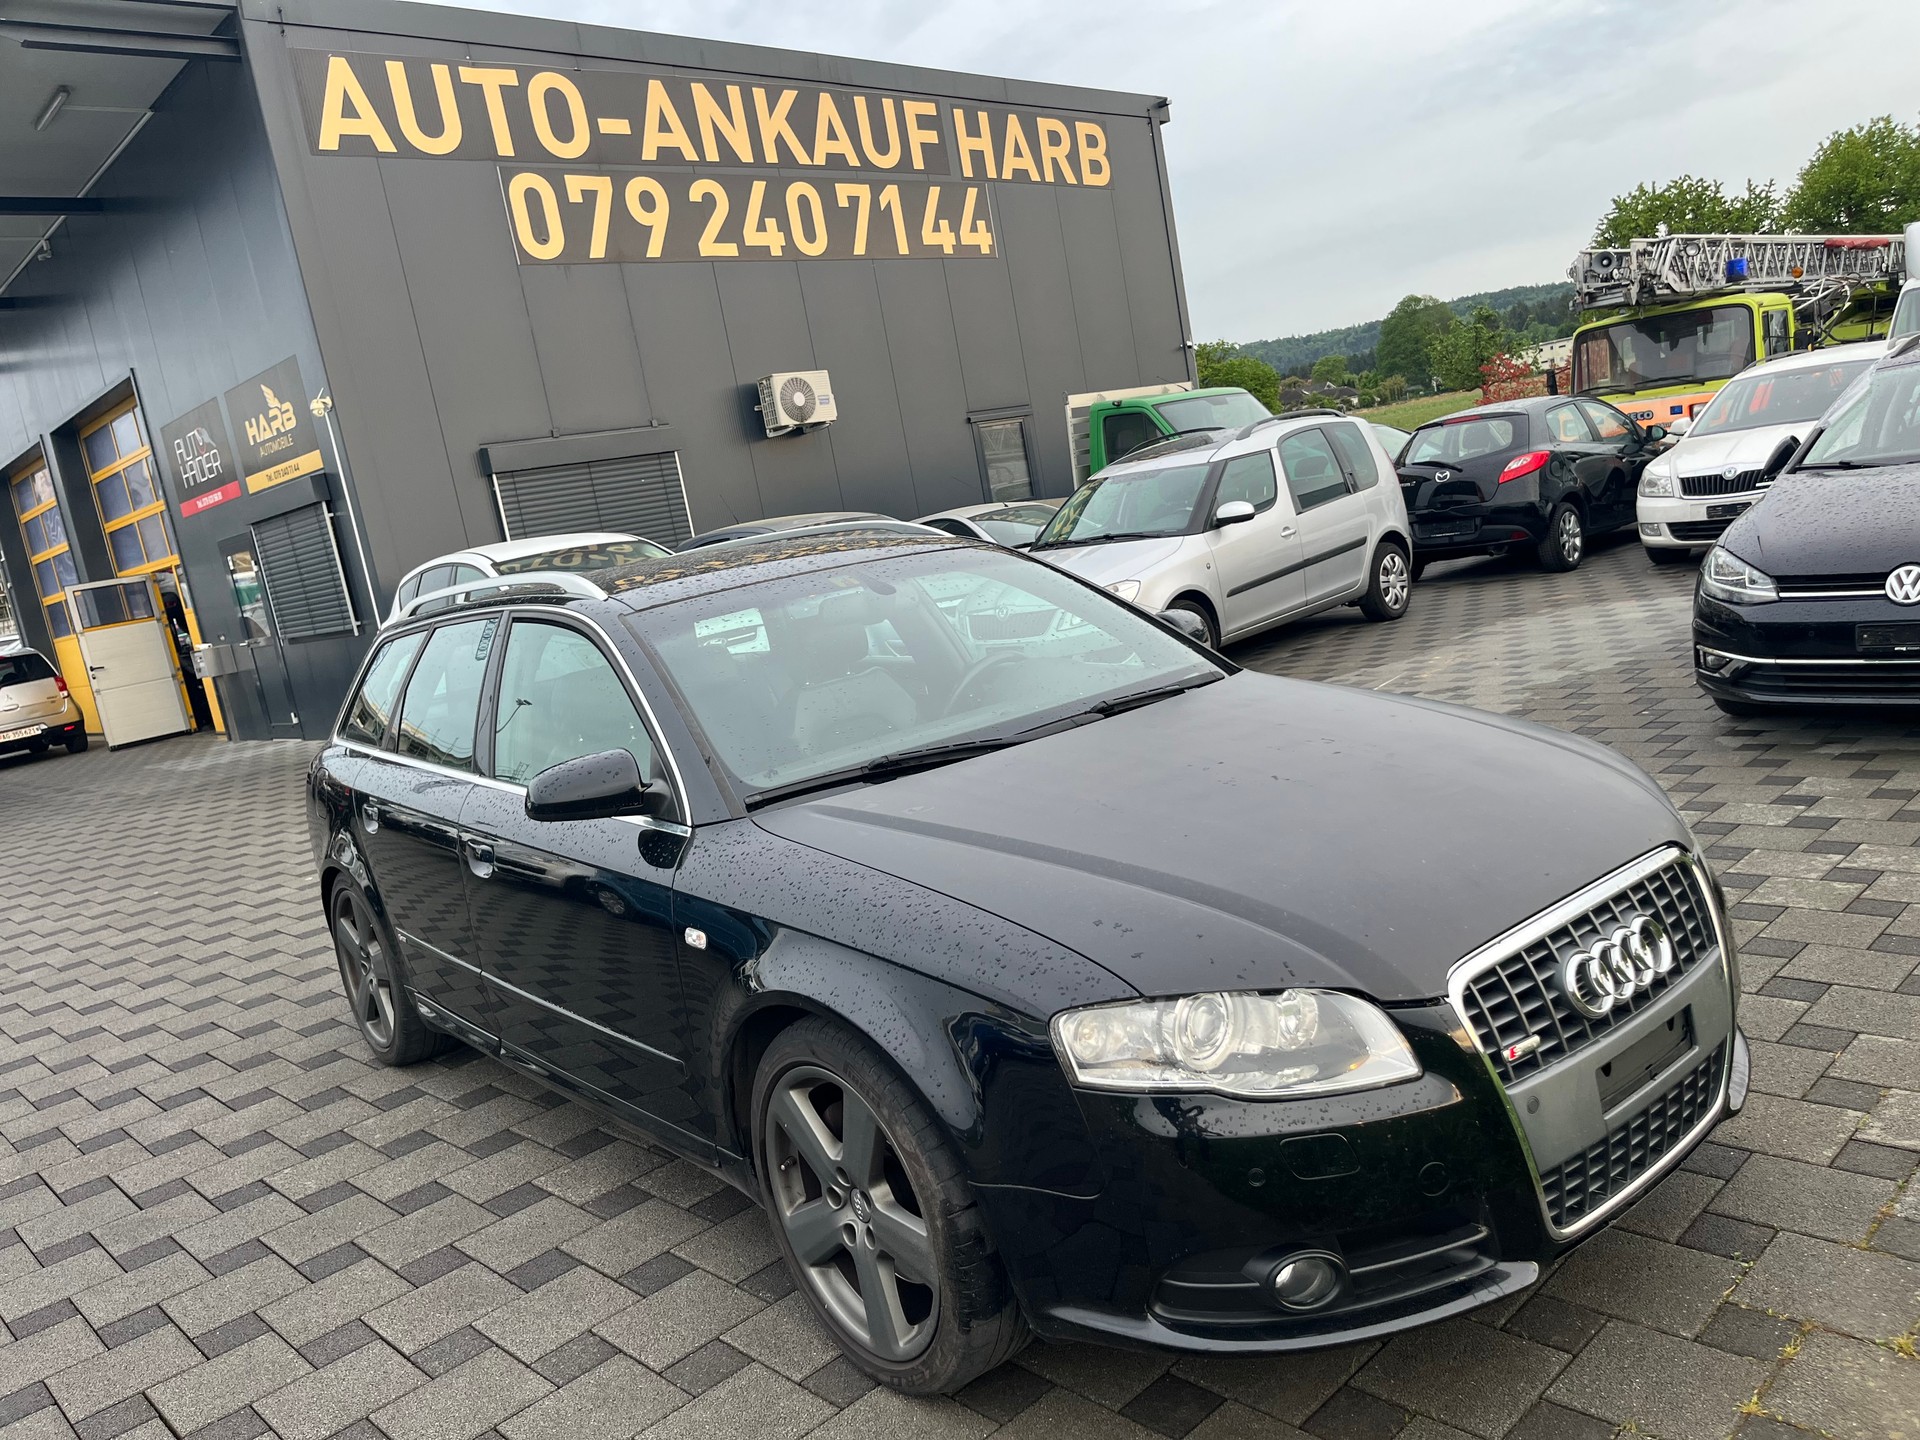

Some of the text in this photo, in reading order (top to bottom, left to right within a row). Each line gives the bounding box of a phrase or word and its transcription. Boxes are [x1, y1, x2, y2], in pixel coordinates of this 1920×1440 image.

[318, 56, 1111, 187] AUTO-ANKAUF HARB
[508, 172, 670, 260] 079
[245, 401, 296, 446] HARB
[260, 433, 294, 457] AUTOMOBILE
